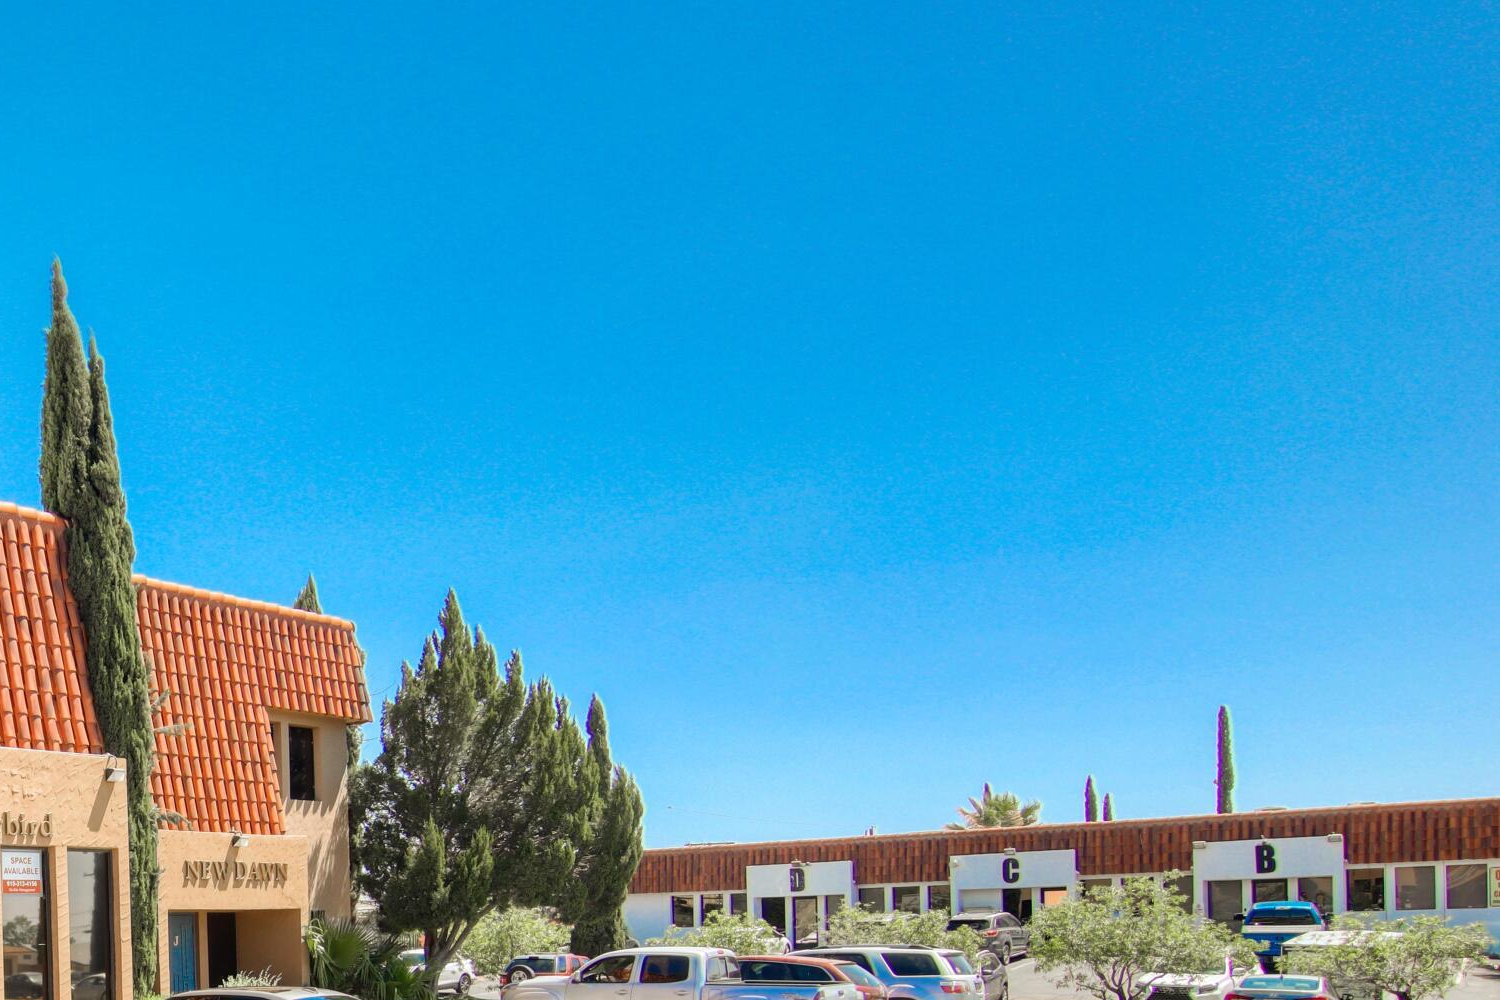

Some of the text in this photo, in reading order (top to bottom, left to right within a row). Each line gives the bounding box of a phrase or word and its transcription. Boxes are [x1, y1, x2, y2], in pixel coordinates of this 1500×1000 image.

[3, 867, 39, 875] AVAILABLE
[184, 860, 288, 882] NEW DAWN
[1002, 857, 1020, 884] C
[1255, 845, 1276, 874] B
[790, 868, 805, 892] D
[173, 935, 179, 947] J
